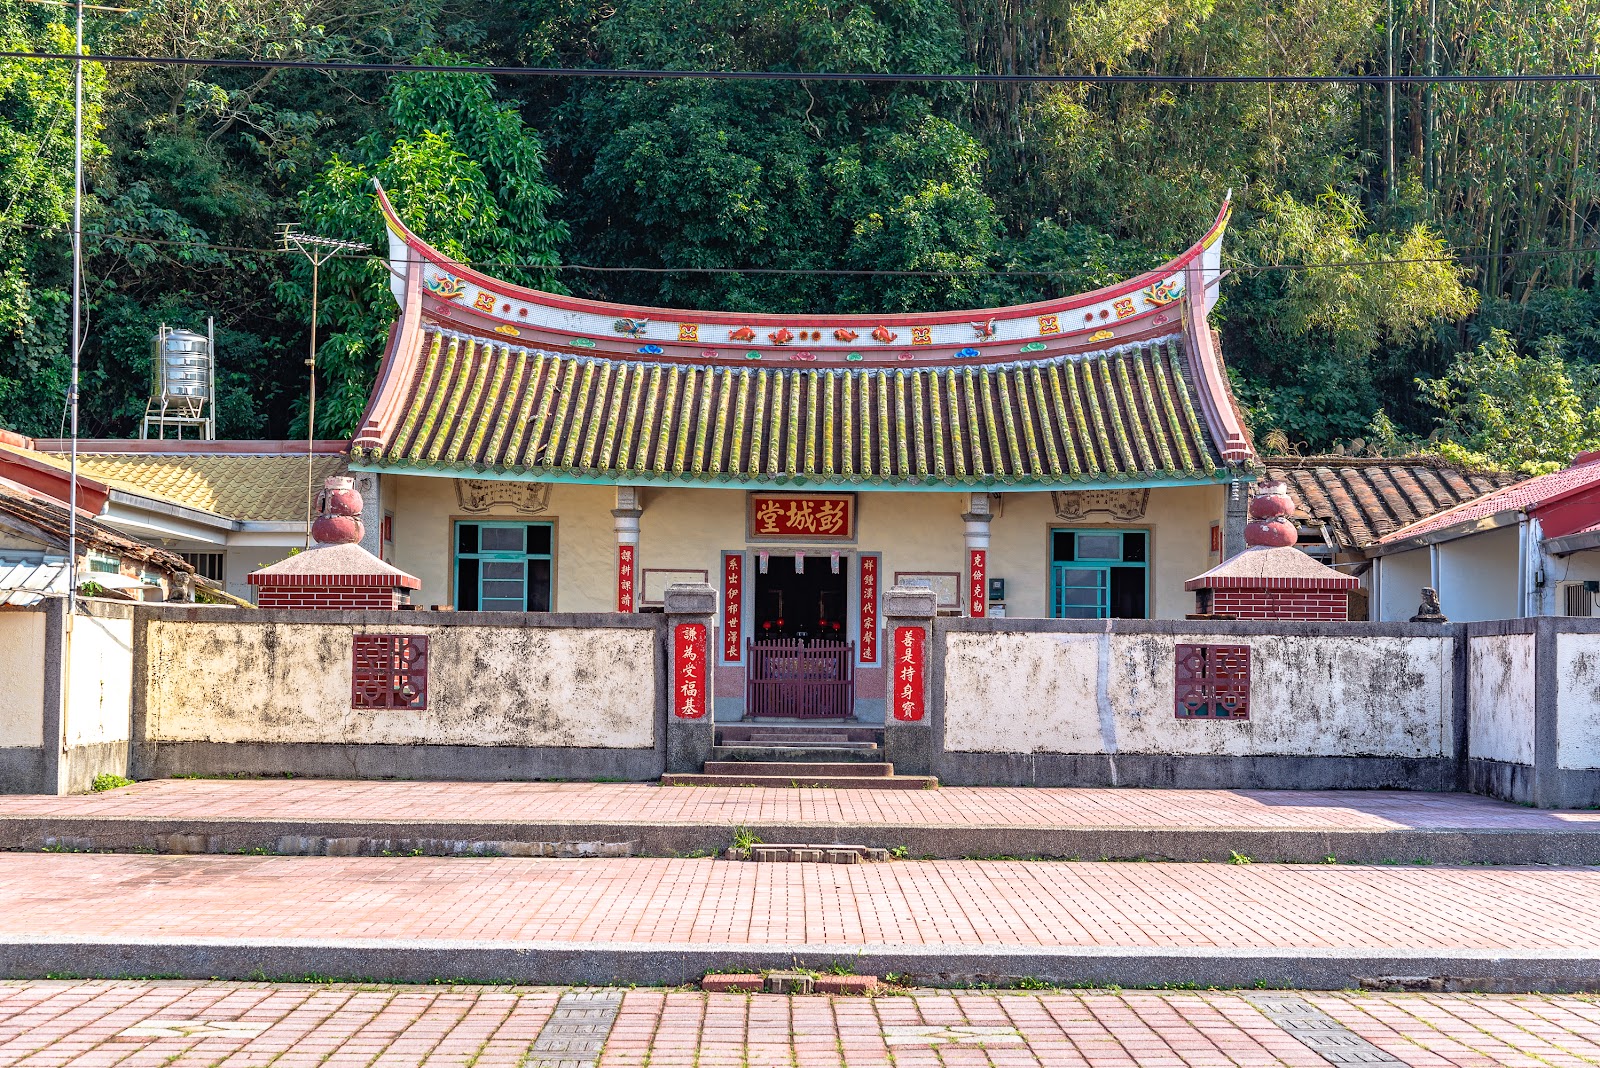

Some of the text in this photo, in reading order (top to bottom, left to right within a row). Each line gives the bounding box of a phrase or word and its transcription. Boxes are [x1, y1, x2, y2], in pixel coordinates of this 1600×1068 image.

[757, 500, 845, 534] 彭城堂
[972, 554, 983, 613] 克儉克勤
[680, 627, 699, 715] 謙為受福基
